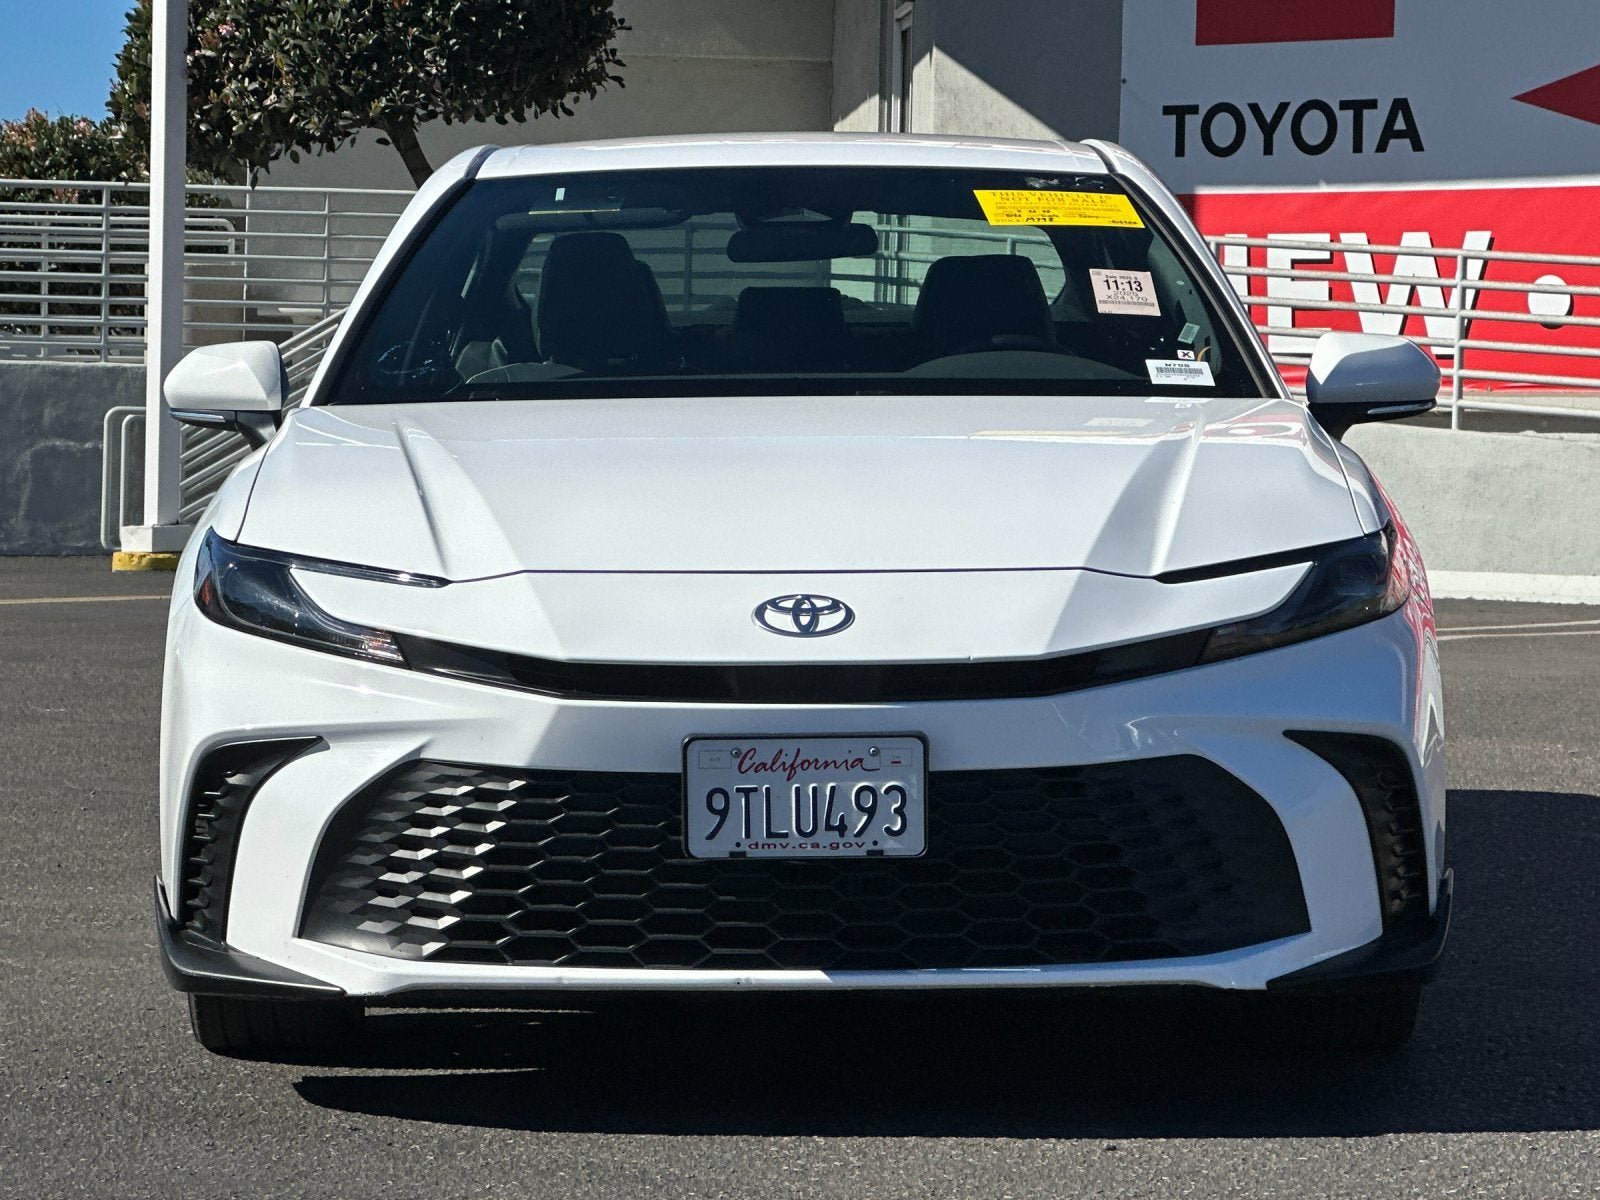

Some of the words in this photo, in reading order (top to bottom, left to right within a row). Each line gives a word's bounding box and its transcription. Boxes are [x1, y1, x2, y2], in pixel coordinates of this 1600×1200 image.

[1161, 97, 1425, 158] TOYOTA
[1103, 279, 1143, 292] 11:13
[737, 747, 881, 782] California
[704, 782, 908, 841] 9TLU493
[747, 840, 867, 850] dmv.ca.gov
